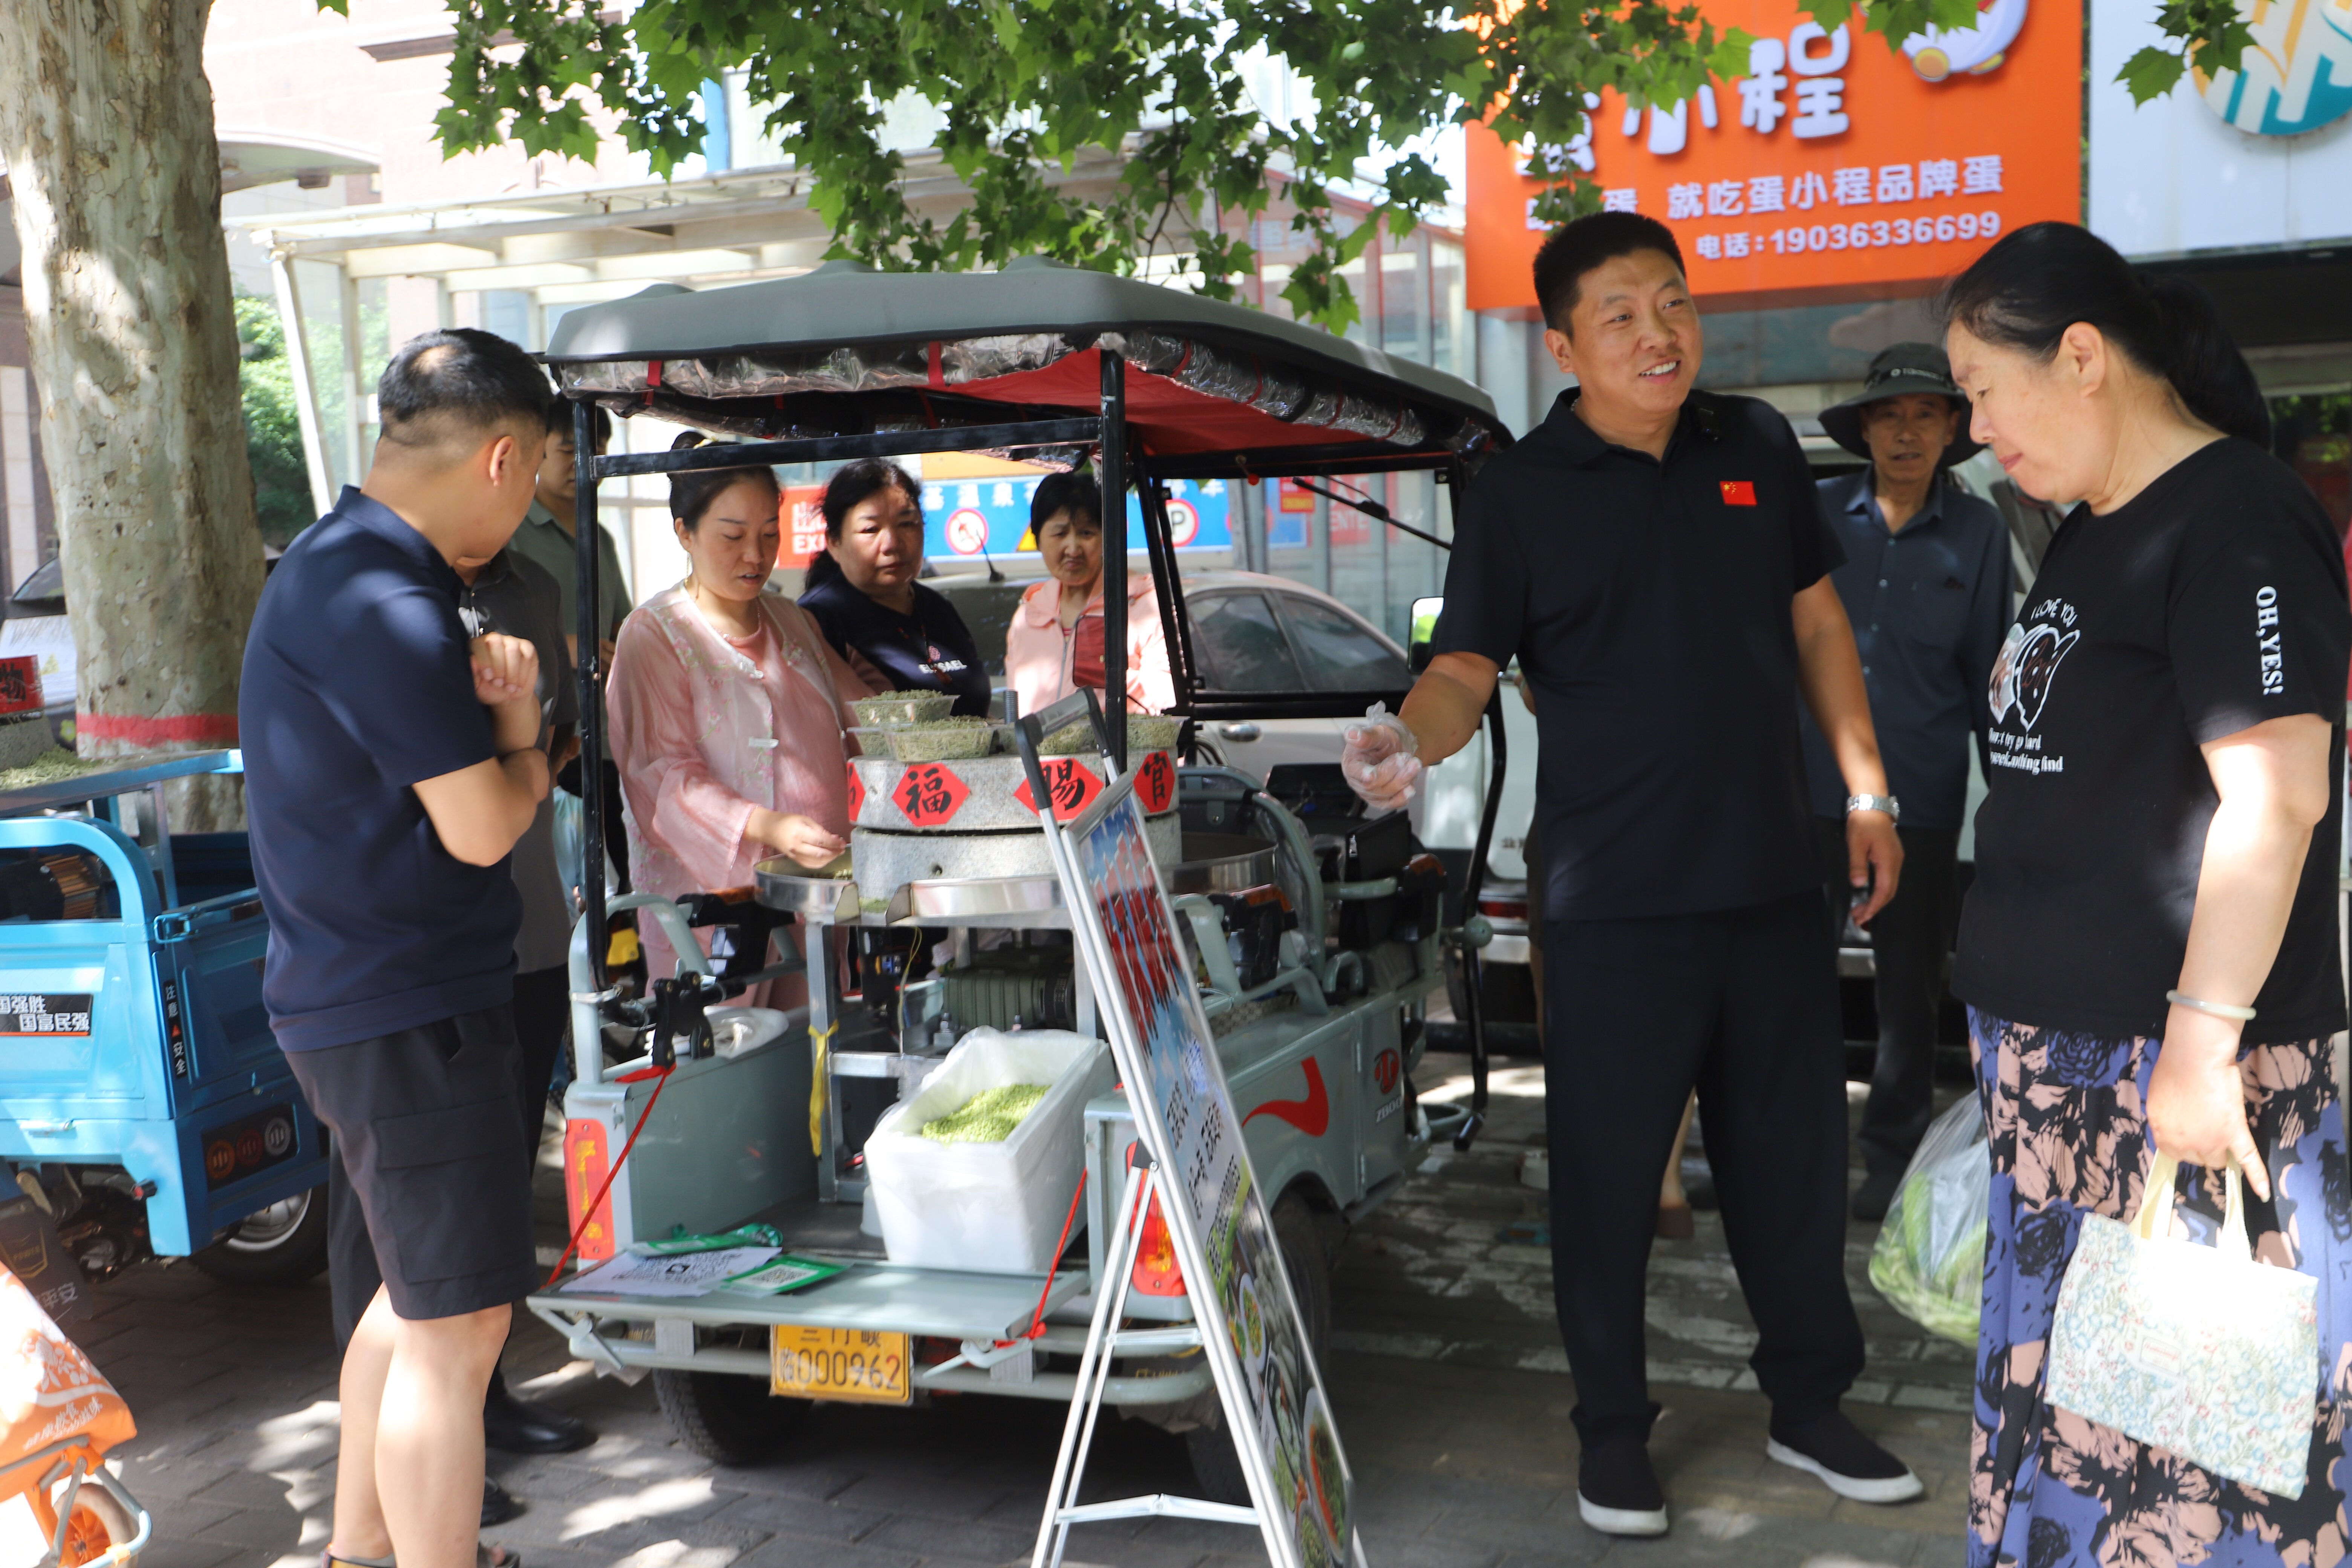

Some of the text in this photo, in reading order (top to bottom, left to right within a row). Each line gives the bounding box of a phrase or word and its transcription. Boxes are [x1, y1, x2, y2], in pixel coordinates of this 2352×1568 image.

[1668, 154, 2004, 220] 就吃蛋小程品牌蛋
[2035, 598, 2062, 619] LOVE
[2060, 603, 2078, 628] YOU
[918, 659, 968, 674] ELSAEL
[2256, 585, 2284, 696] OH,YES!
[906, 767, 952, 819] 福
[1143, 752, 1168, 807] 官
[0, 995, 47, 1015] 国强胜
[19, 1012, 90, 1032] 国富民强
[165, 984, 187, 1075] 注意 安全
